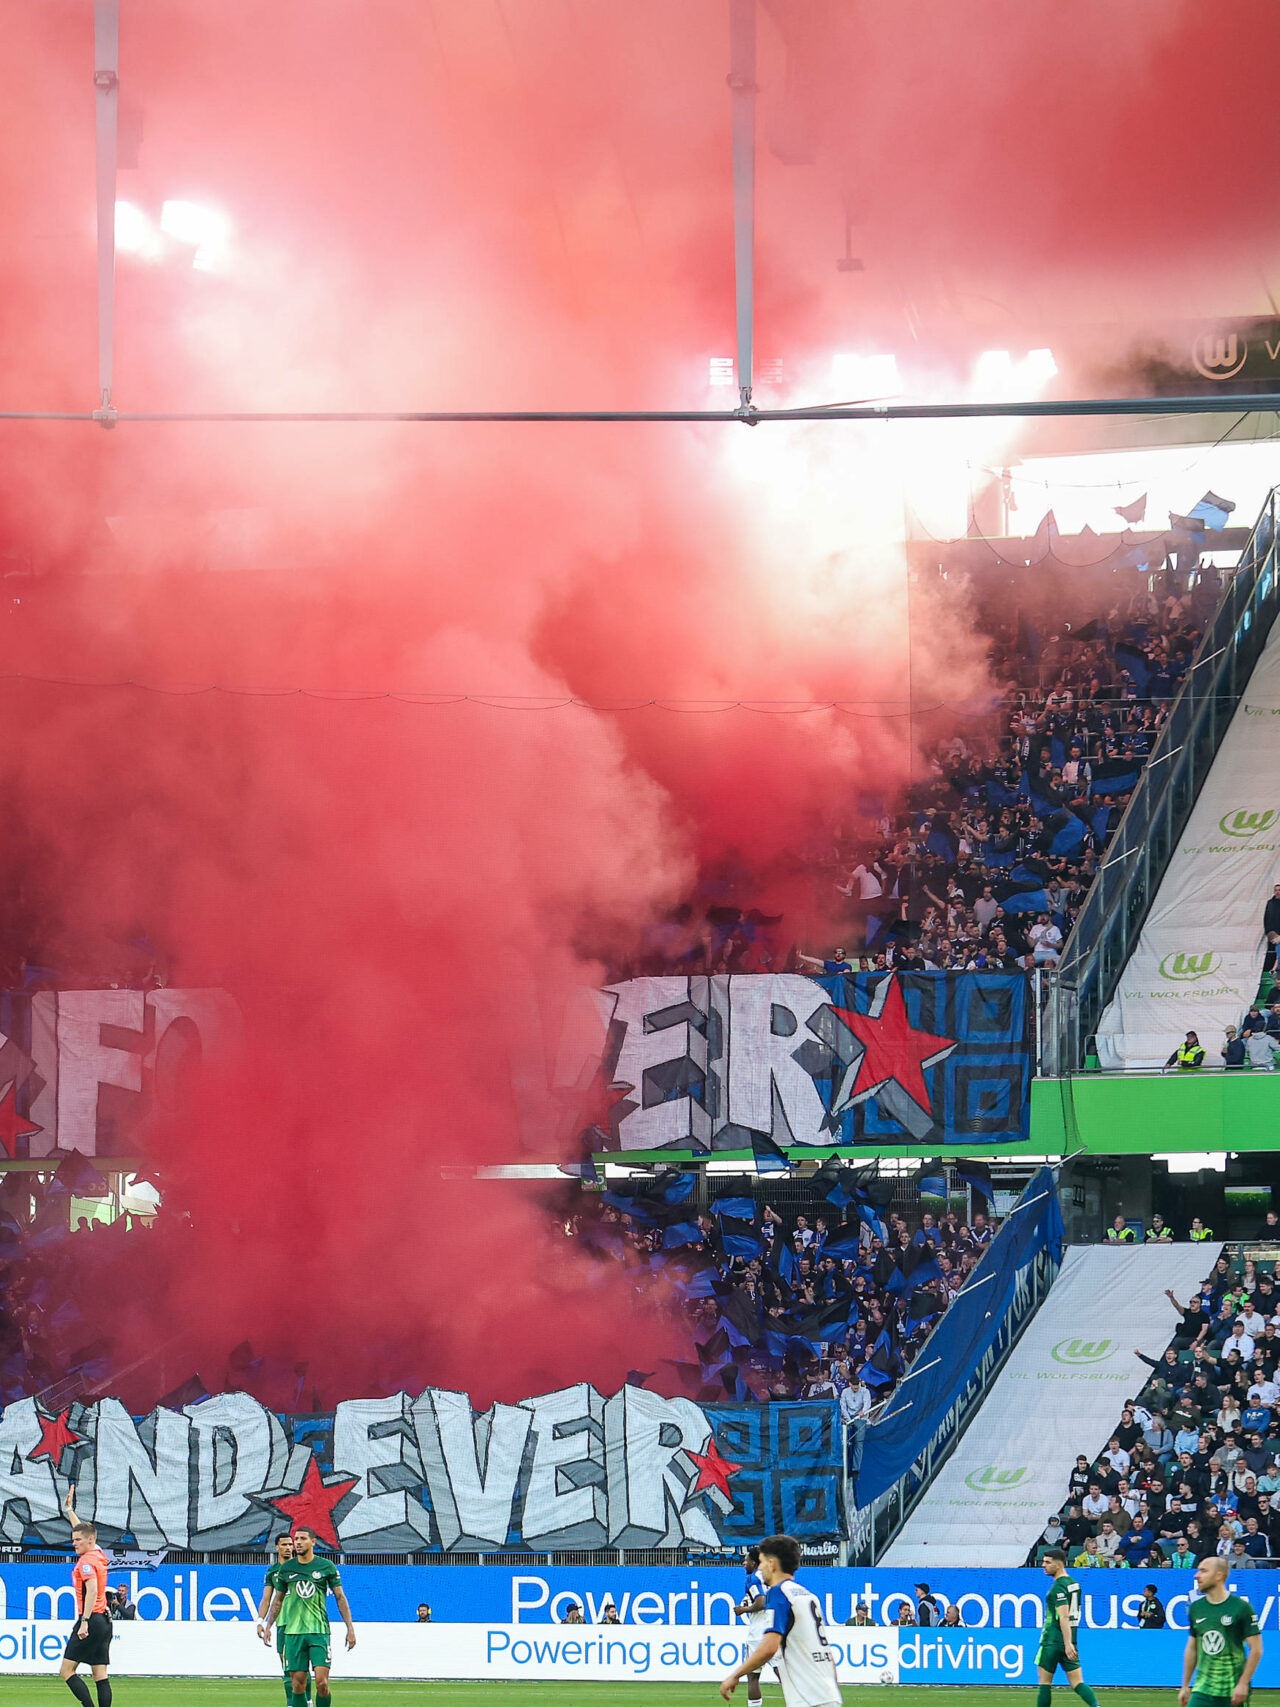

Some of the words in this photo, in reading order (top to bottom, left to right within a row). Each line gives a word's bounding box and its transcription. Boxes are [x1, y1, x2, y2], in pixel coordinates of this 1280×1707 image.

[327, 1382, 724, 1550] EVER
[800, 1541, 838, 1556] Charlie
[487, 1631, 651, 1673] Powering
[898, 1633, 1024, 1679] driving
